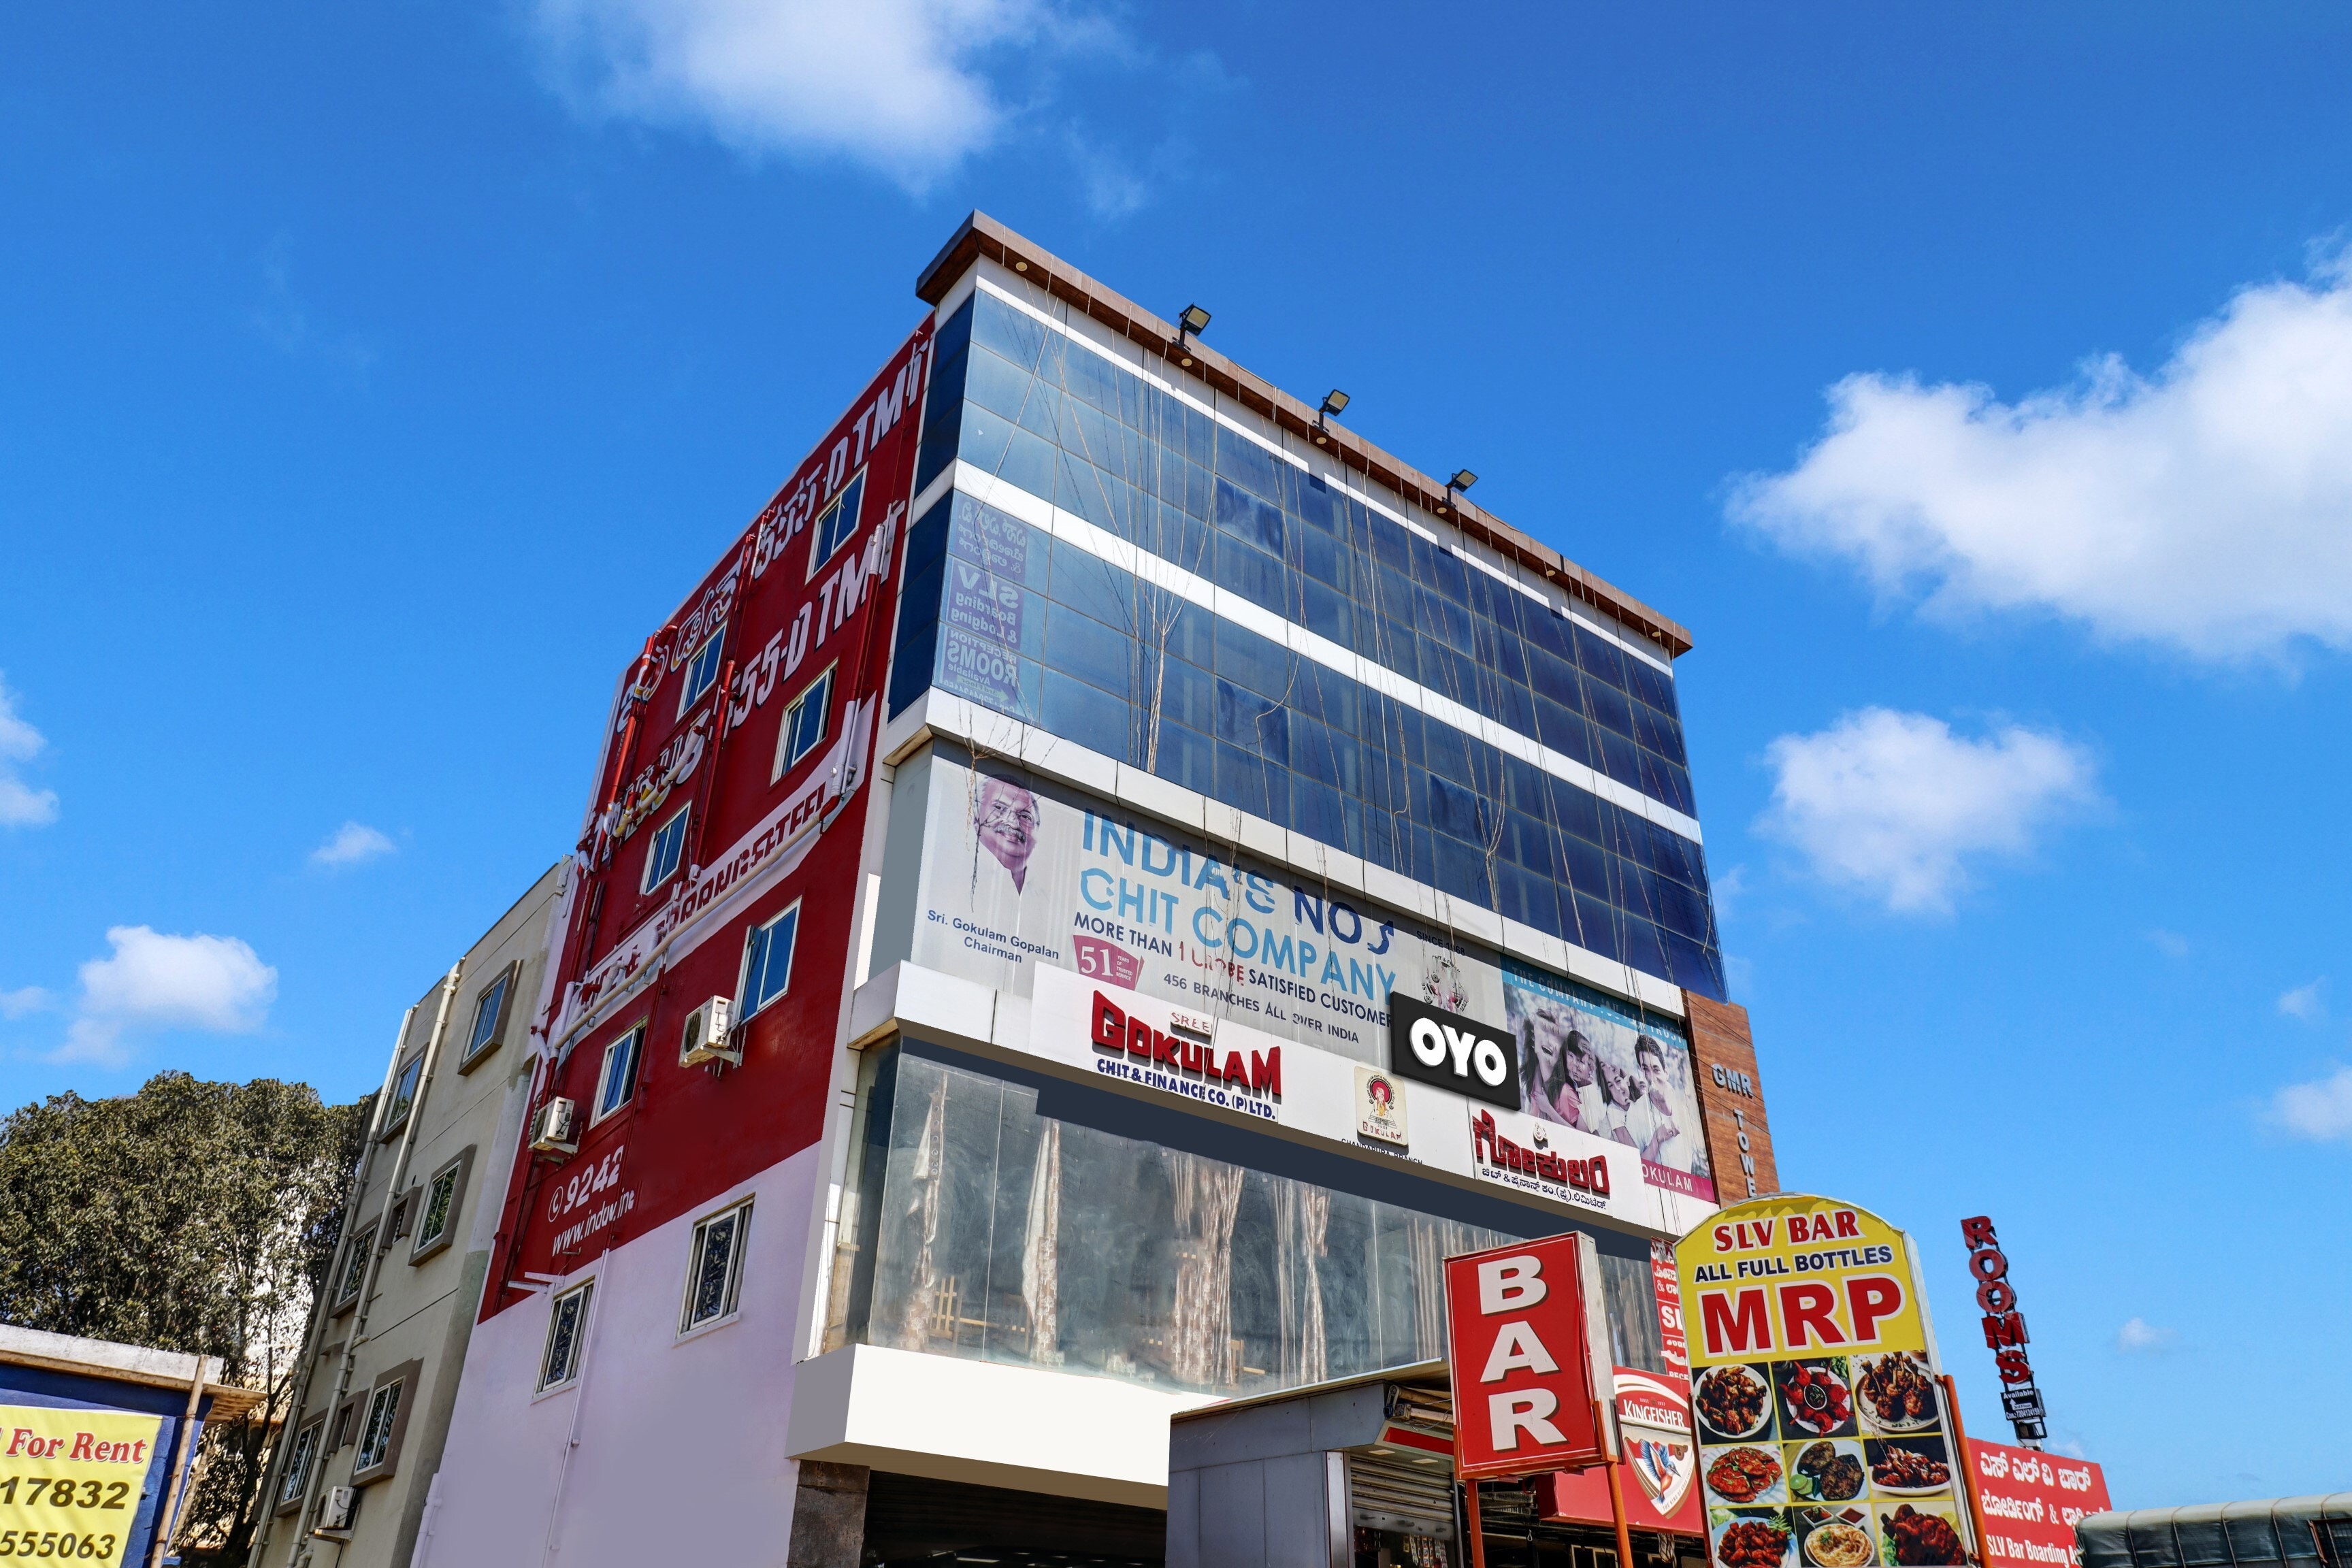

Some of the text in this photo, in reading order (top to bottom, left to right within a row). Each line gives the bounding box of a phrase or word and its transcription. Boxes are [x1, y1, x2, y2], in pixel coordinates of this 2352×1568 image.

[815, 500, 906, 649] TMT
[928, 910, 1060, 960] Sri. Gokulam Gopalan
[964, 936, 1022, 964] Chairman
[1080, 868, 1395, 1006] CHIT COMPANY
[1416, 930, 1443, 949] SINCE
[1074, 912, 1124, 941] MORE
[1129, 930, 1172, 957] THAN
[1248, 968, 1316, 1003] SATISFIED
[1320, 993, 1391, 1028] CUSTOMER
[1081, 945, 1114, 977] 51
[1115, 972, 1132, 981] SERVICE
[1116, 966, 1133, 976] TRUSTED
[1512, 966, 1535, 988] THE
[1163, 973, 1187, 990] 456
[1194, 982, 1260, 1012] BRANCHES
[1265, 1002, 1287, 1021] ALL
[1328, 1024, 1360, 1044] INDIA
[1091, 990, 1282, 1098] GOKULAM
[1409, 1017, 1507, 1088] OYO
[1097, 1058, 1130, 1079] CHIT
[1131, 1067, 1141, 1082] &
[1145, 1071, 1207, 1100] FINANCE
[1710, 1063, 1754, 1100] GMR
[1472, 1109, 1610, 1195] ಗೋಕುಲಂ
[1734, 1107, 1758, 1198] TOWE
[1642, 1163, 1693, 1192] OKULAM
[1713, 1211, 1861, 1252] SLV BAR
[1695, 1262, 1731, 1283] ALL
[1737, 1257, 1790, 1278] FULL
[1795, 1245, 1893, 1273] BOTTLES
[1661, 1305, 1684, 1331] SL
[1700, 1276, 1902, 1354] MRP
[1961, 1215, 2030, 1384] ROOMS
[1477, 1254, 1569, 1452] BAR
[2003, 1389, 2034, 1399] Available
[1623, 1399, 1684, 1428] KINGFISHER
[6, 1428, 65, 1458] For
[69, 1432, 148, 1464] Rent
[2048, 1503, 2059, 1525] &
[1985, 1534, 2006, 1557] SLV
[2006, 1537, 2025, 1560] Bar
[2024, 1539, 2070, 1568] Boarding
